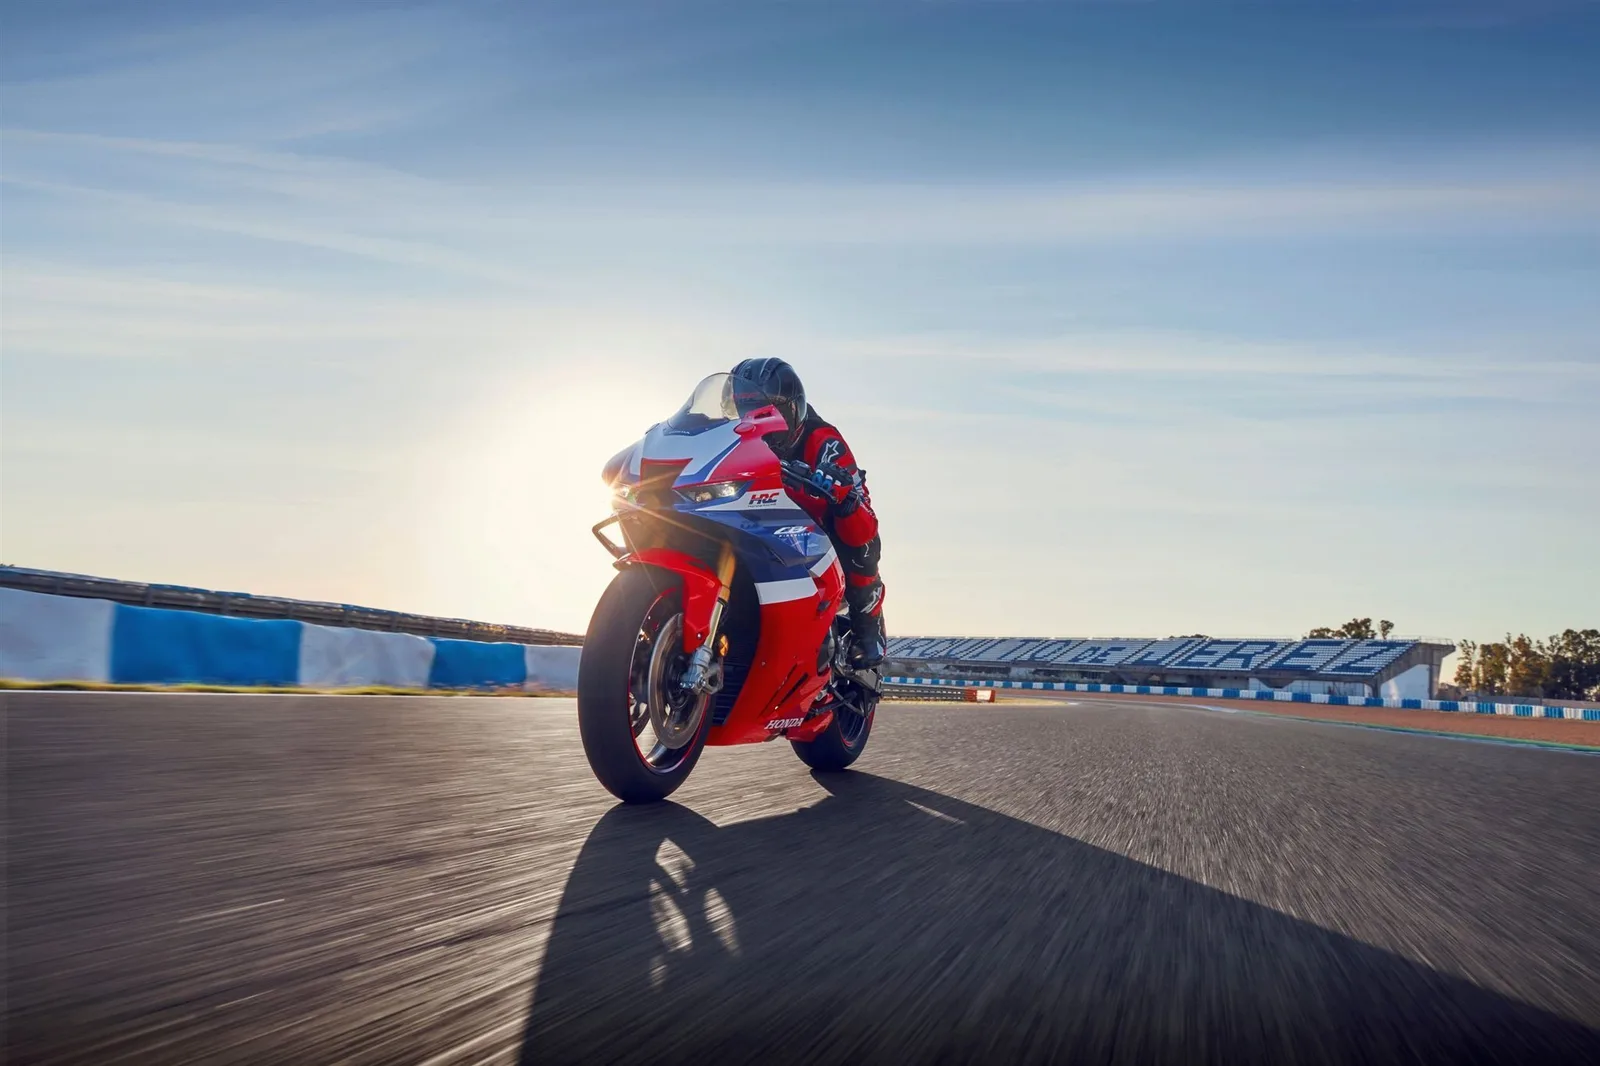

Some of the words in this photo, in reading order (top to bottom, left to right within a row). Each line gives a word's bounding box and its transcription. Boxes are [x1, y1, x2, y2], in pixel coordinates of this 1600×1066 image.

[748, 492, 780, 505] HRC
[886, 637, 1072, 662] IRCUITO
[1129, 638, 1416, 674] JEREZ
[763, 717, 805, 730] HONDA
